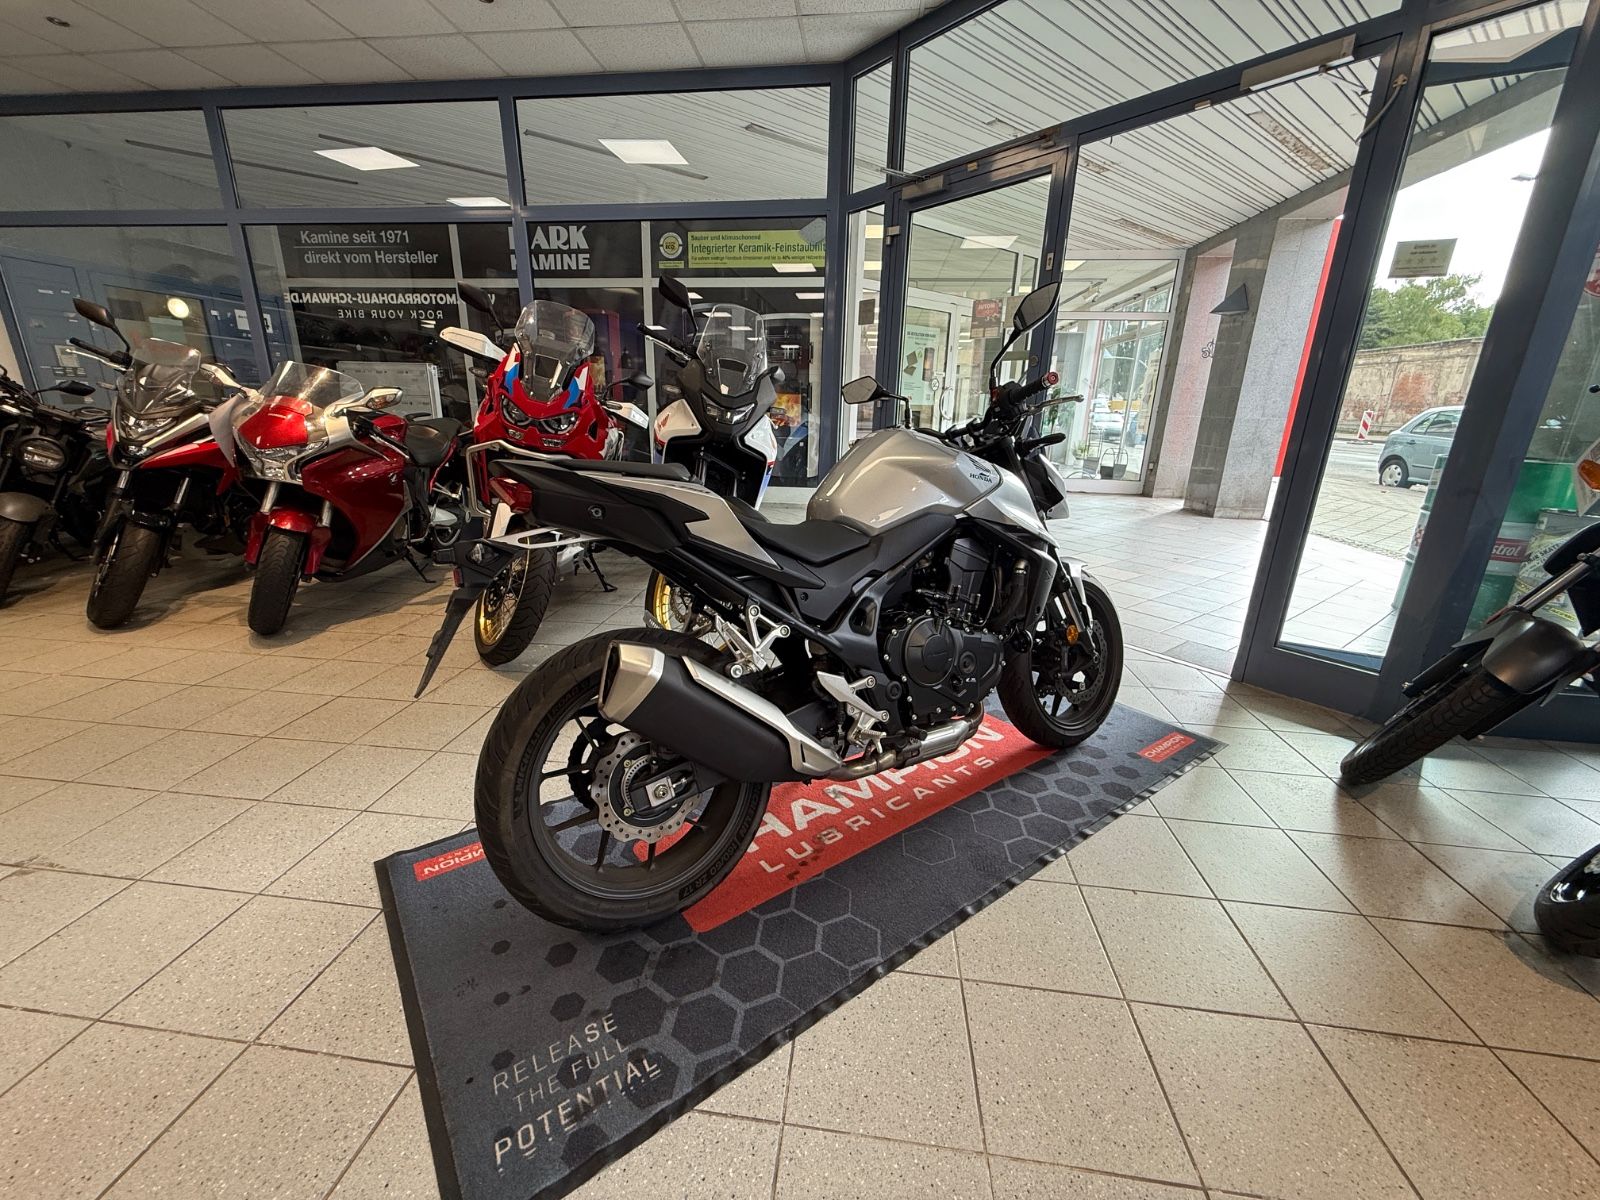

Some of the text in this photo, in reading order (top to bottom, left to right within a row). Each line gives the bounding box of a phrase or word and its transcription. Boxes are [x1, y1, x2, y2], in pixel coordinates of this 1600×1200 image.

[300, 230, 409, 243] Kamine seit 1971
[304, 250, 439, 264] direkt vom Hersteller
[691, 242, 826, 255] Integrierter Keramik-Feinstaubfil
[510, 253, 591, 270] AMINE
[969, 472, 993, 484] HONDA
[1492, 544, 1521, 557] strol
[746, 721, 1005, 853] HAMPION
[758, 756, 996, 874] LUBRICANTS
[423, 848, 485, 875] MPION
[493, 1013, 618, 1095] RELEASE
[512, 1038, 629, 1112] THE FULL
[494, 1055, 661, 1172] POTENTIAL
